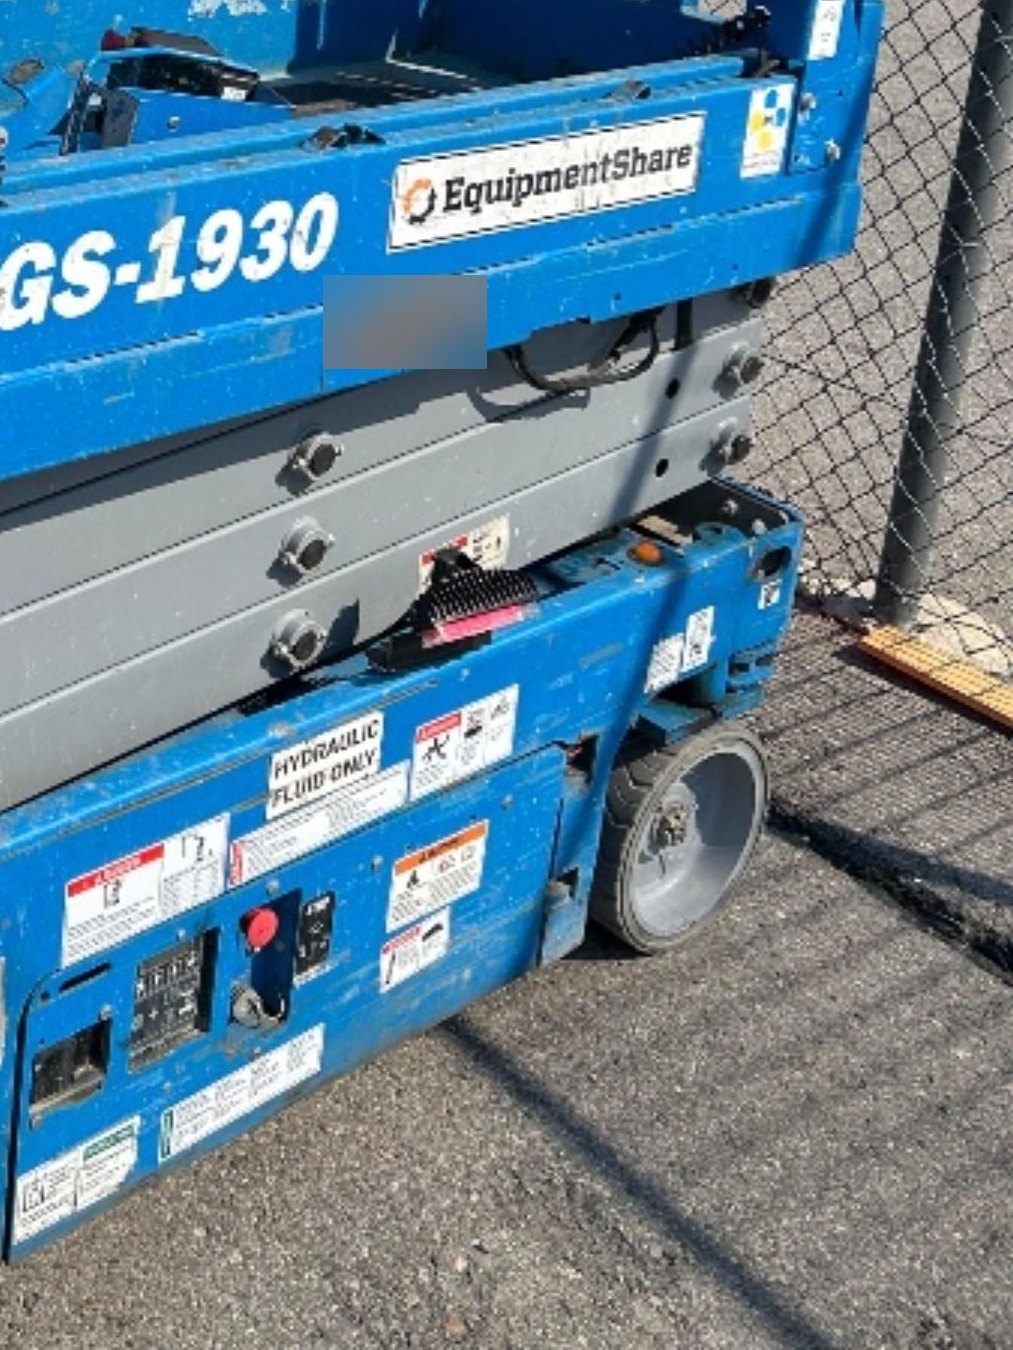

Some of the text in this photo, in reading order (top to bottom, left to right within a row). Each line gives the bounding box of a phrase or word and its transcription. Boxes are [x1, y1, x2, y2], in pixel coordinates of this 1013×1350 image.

[442, 143, 693, 217] EquipmentShare
[271, 748, 376, 808] FLUID ONLY
[274, 718, 379, 781] HYDRAULIC
